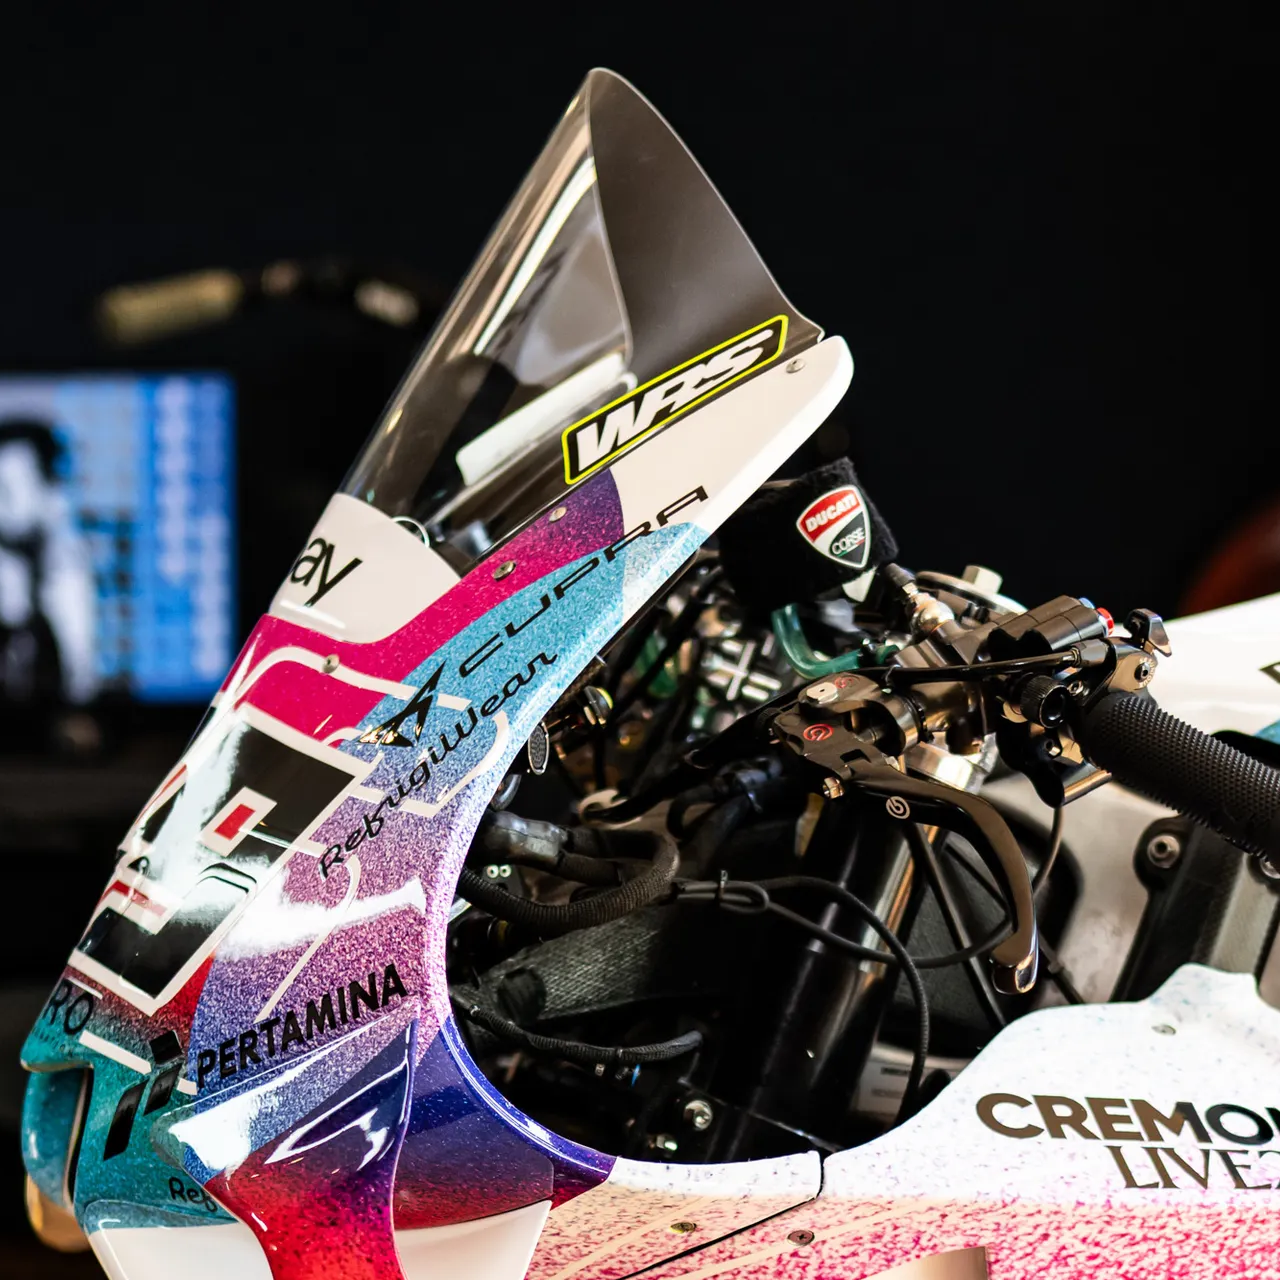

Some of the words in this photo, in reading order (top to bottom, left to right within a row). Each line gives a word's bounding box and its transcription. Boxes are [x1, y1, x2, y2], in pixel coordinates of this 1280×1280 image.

[575, 326, 780, 475] WRS
[805, 493, 858, 533] DUCATI
[831, 527, 865, 555] CORSE
[288, 536, 363, 608] ay
[457, 484, 710, 679] CUPRA
[193, 962, 410, 1088] PERTAMINA
